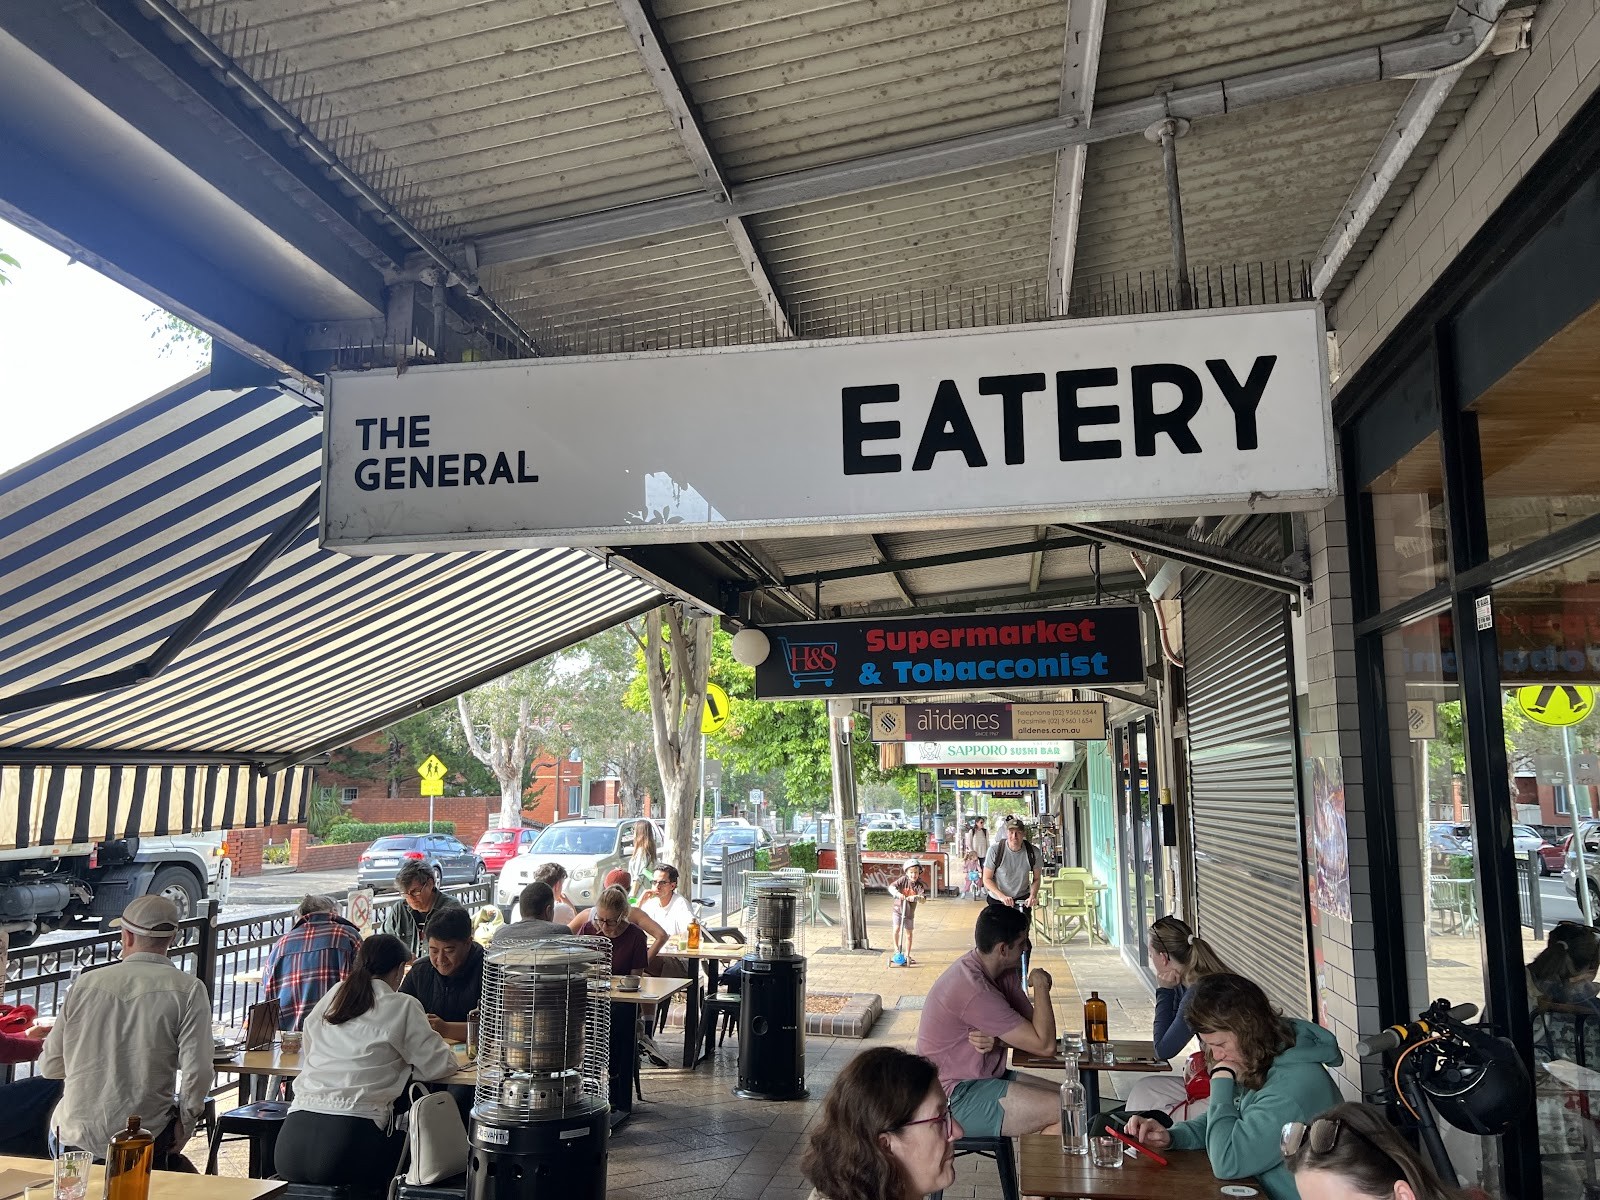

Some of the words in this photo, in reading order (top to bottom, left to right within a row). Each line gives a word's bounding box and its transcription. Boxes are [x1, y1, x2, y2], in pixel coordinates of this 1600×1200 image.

[841, 354, 1278, 476] EATERY
[355, 414, 431, 451] THE
[354, 450, 538, 492] GENERAL
[866, 619, 1095, 654] Supermarket
[790, 645, 837, 672] H&S
[858, 662, 883, 686] &
[892, 652, 1109, 684] Tobacconist
[917, 708, 1000, 731] alidenes
[1017, 709, 1050, 717] Telephone
[1052, 709, 1065, 717] (02)
[1048, 717, 1060, 725] (02)
[947, 744, 1008, 757] SAPPORO
[1010, 746, 1038, 756] SUSHI
[1040, 746, 1061, 755] BAR
[943, 767, 965, 775] THE
[967, 767, 999, 775] SMILE
[1001, 767, 1030, 775] SPOT
[956, 779, 982, 789] USED
[984, 779, 1039, 788] FURNITURE
